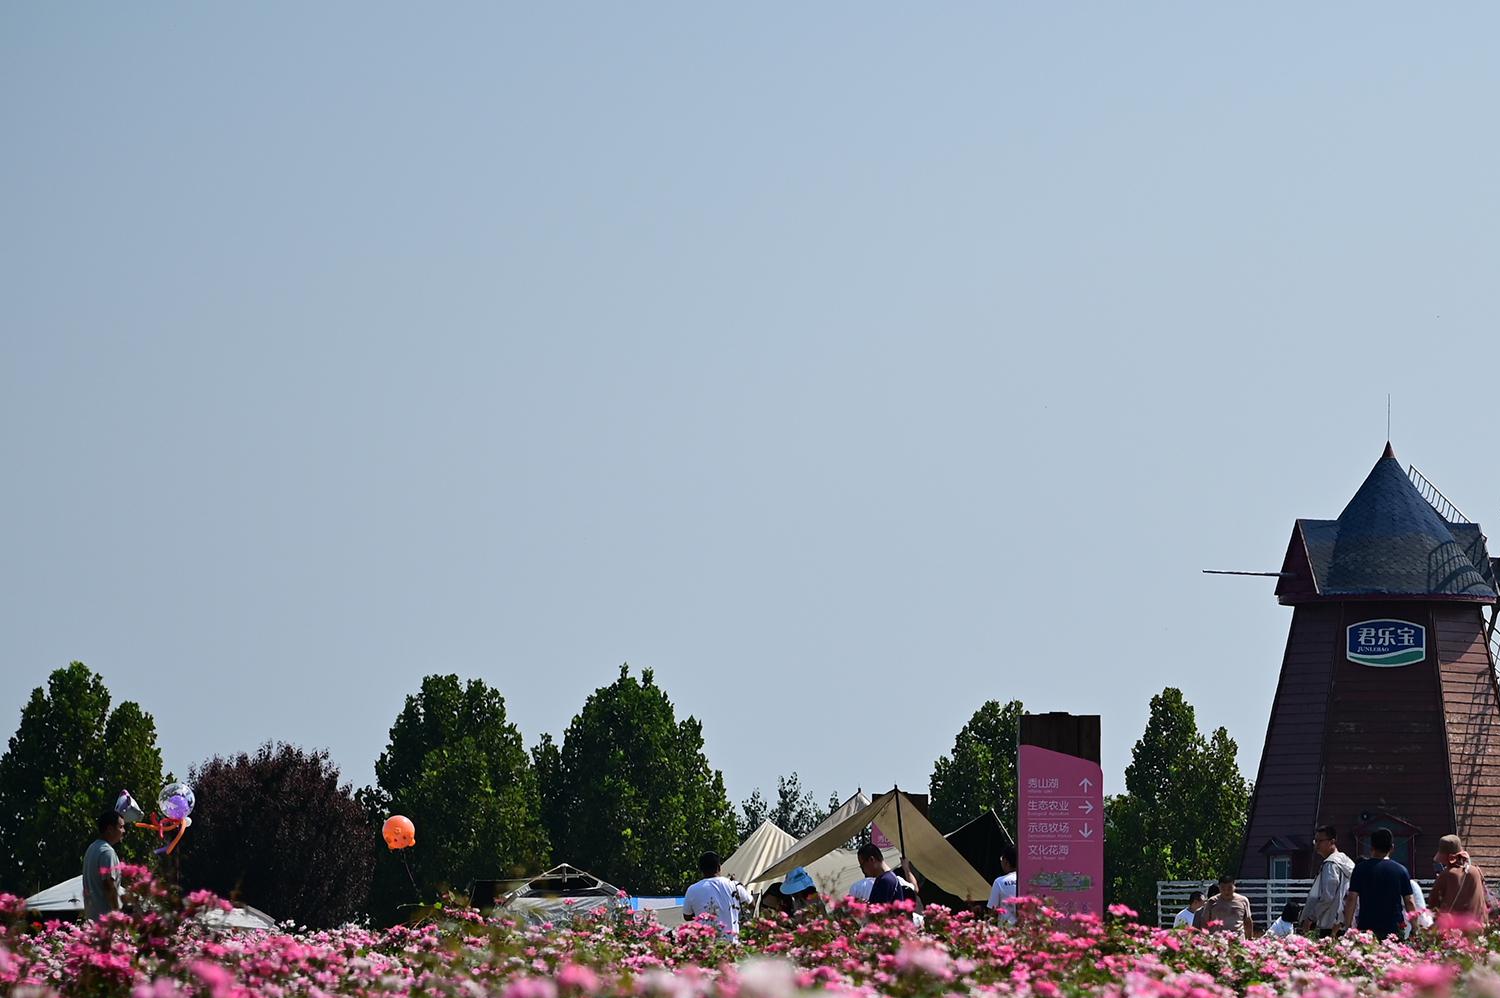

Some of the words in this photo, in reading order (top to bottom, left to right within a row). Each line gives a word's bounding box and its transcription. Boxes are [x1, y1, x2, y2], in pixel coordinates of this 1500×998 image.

[1357, 627, 1415, 646] 君乐宝
[1028, 778, 1059, 789] 秀山湖
[1028, 800, 1069, 811] 生态农业
[1028, 822, 1070, 833] 示范牧场
[1028, 844, 1069, 856] 文化花海
